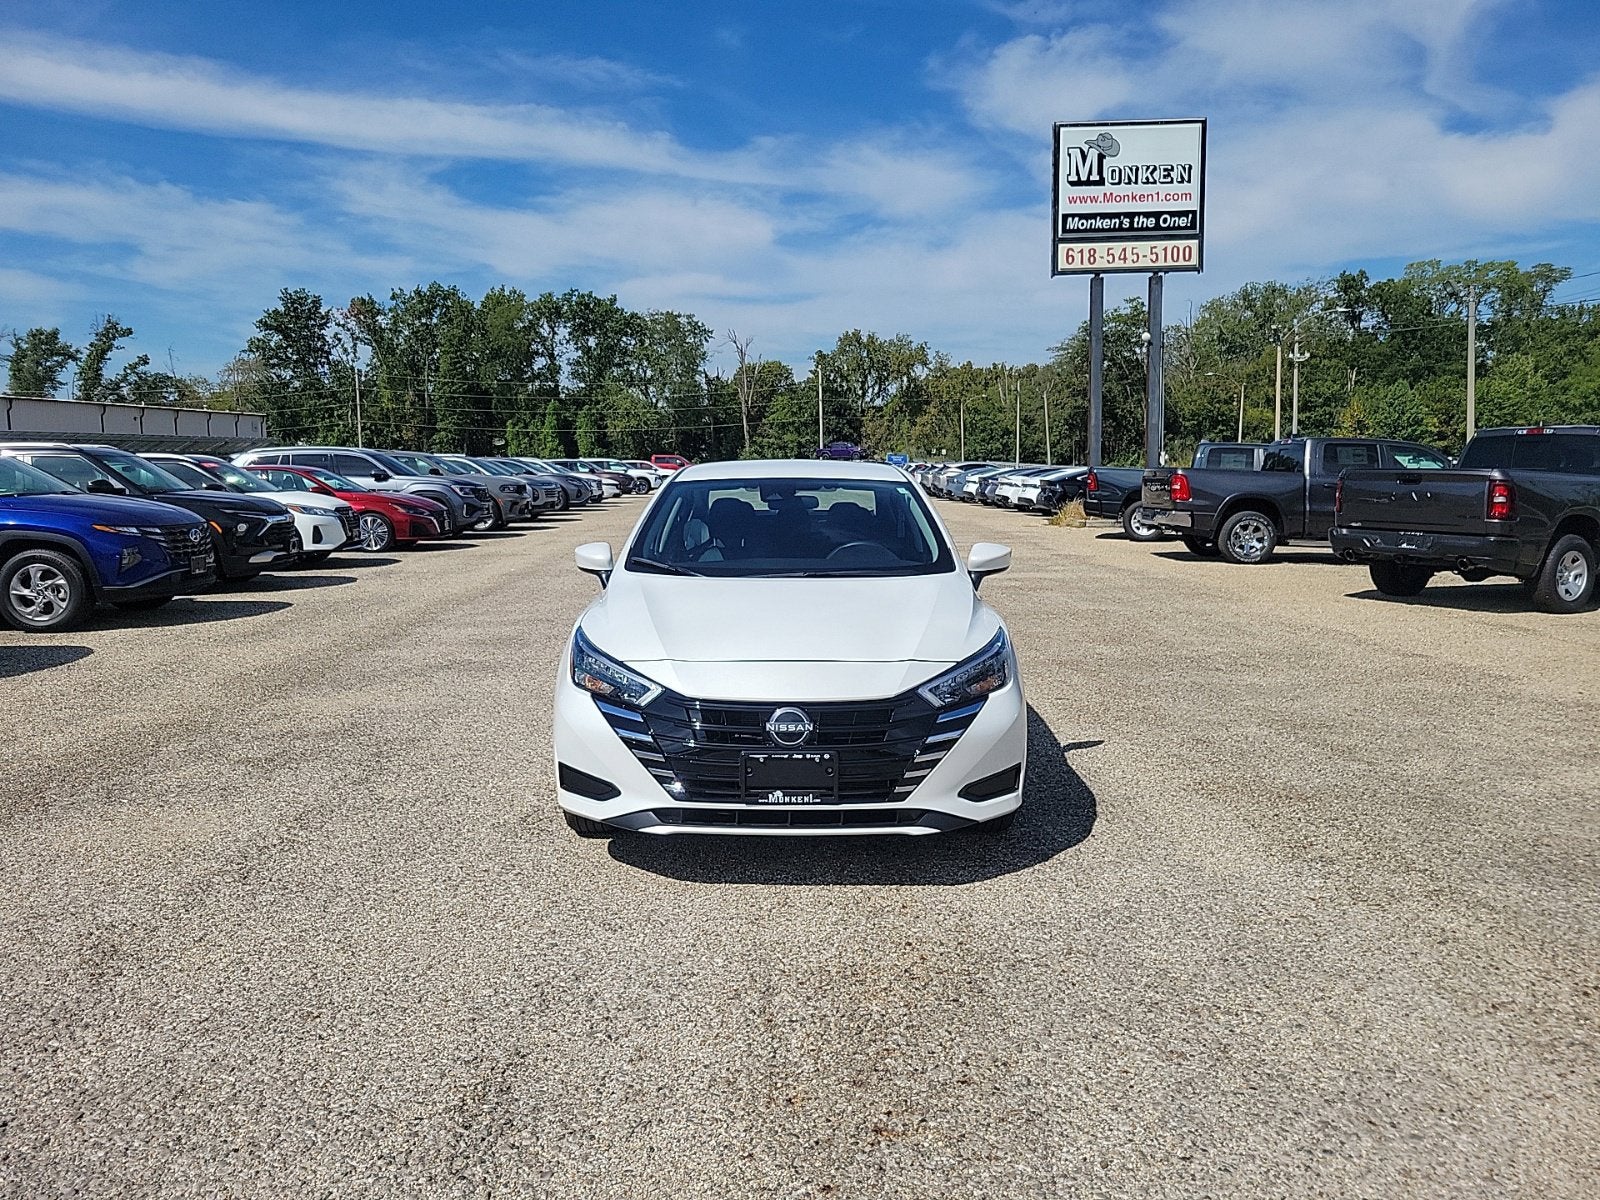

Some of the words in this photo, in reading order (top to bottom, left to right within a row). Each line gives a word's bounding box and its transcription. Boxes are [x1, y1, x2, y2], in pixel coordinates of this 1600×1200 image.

[1067, 146, 1193, 187] MONKEN
[1068, 191, 1192, 205] www.Monken1.com
[1066, 215, 1130, 230] Monken's
[1133, 214, 1156, 228] the
[1159, 213, 1192, 228] One!
[1065, 245, 1193, 265] 618-545-5100
[766, 723, 813, 732] NISSAN
